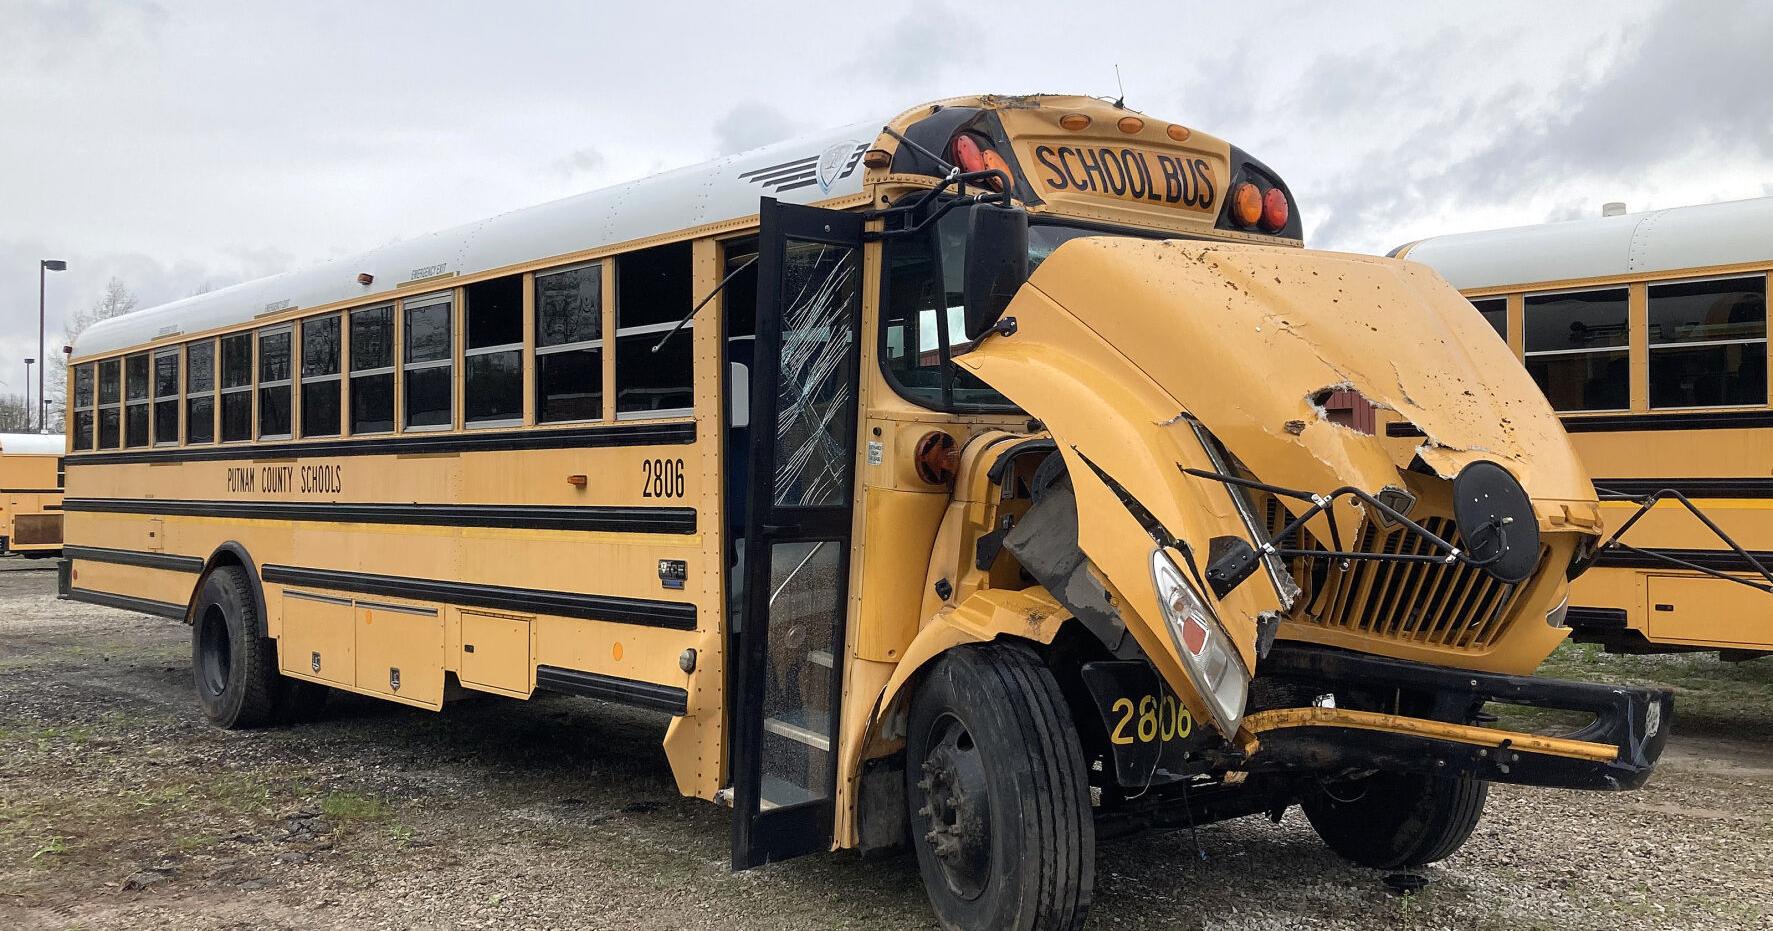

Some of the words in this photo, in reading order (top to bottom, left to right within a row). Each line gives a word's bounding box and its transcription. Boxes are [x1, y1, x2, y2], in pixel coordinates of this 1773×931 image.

[1035, 145, 1161, 201] SCHOOL
[1156, 155, 1215, 210] BUS
[227, 467, 255, 493] PUTNAM
[261, 466, 293, 493] COUNTY
[301, 464, 341, 494] SCHOOLS
[642, 458, 685, 498] 2806
[1111, 694, 1192, 745] 2806
